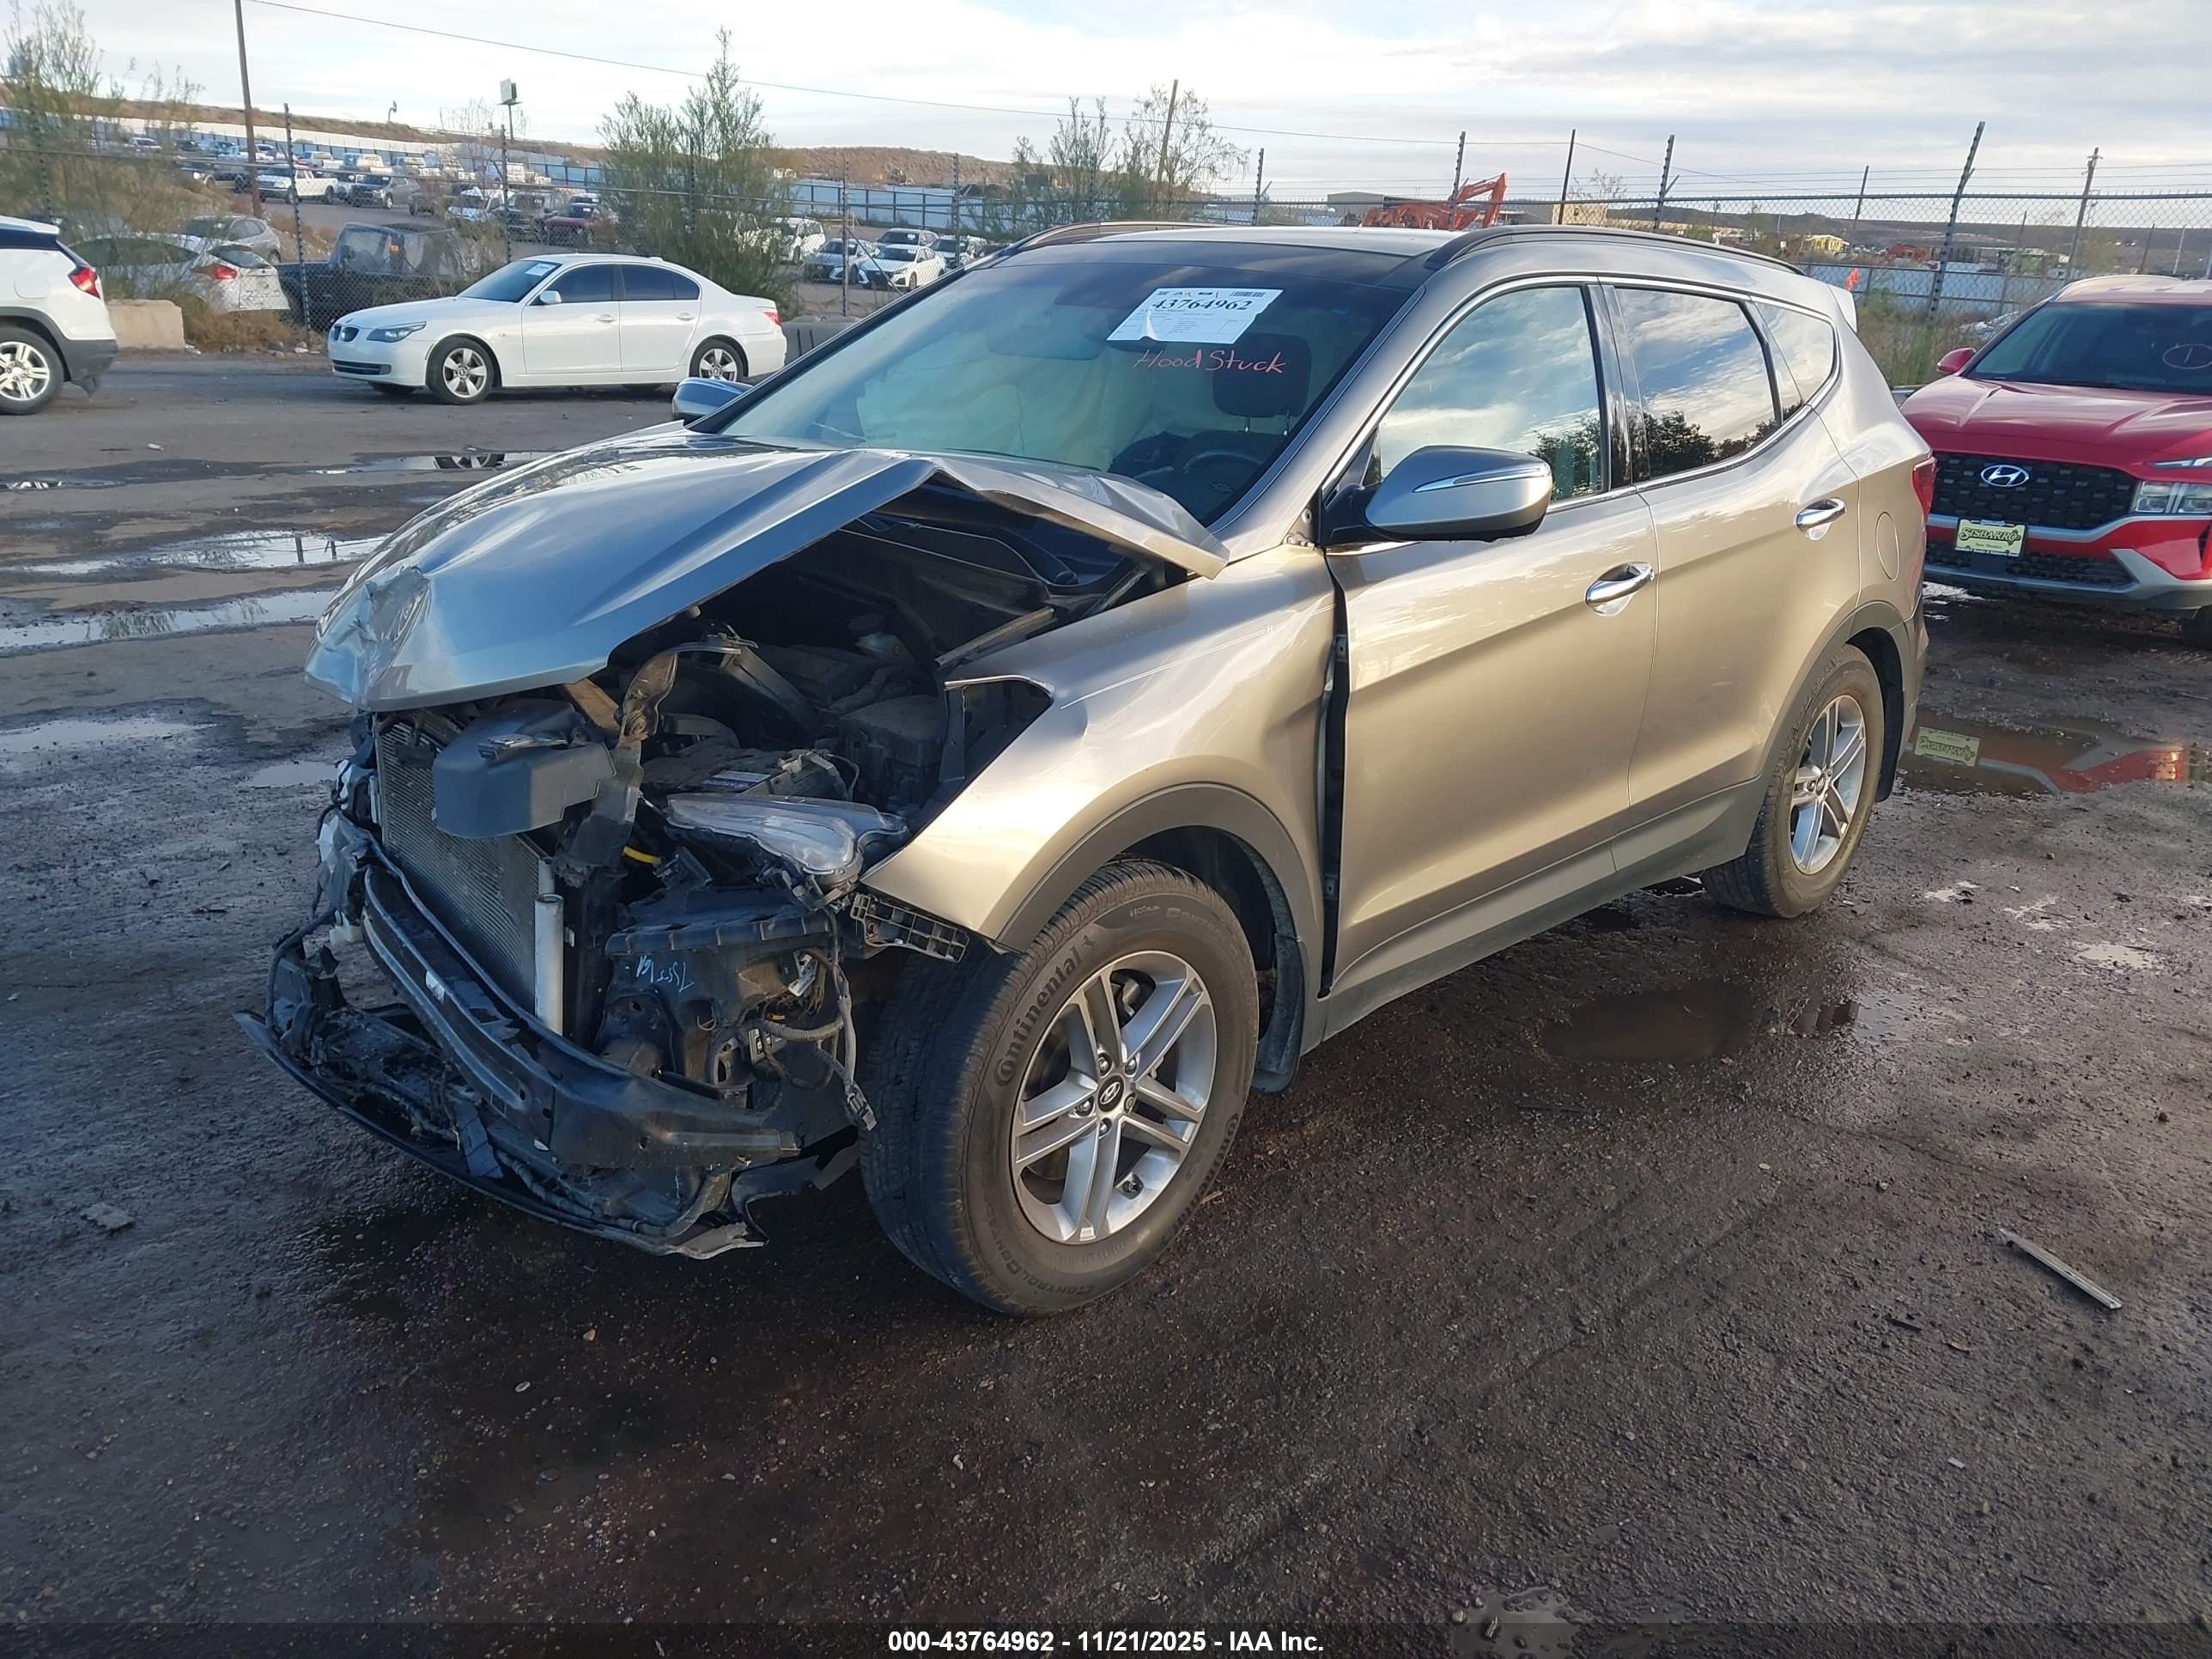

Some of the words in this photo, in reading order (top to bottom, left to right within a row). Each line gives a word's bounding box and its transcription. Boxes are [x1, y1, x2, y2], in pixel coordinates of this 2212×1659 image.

[1152, 299, 1253, 310] 43764962
[1133, 349, 1202, 369] Hood
[1205, 350, 1286, 374] Stuck
[1959, 527, 2018, 542] SISBARRO
[994, 947, 1083, 1086] Continental
